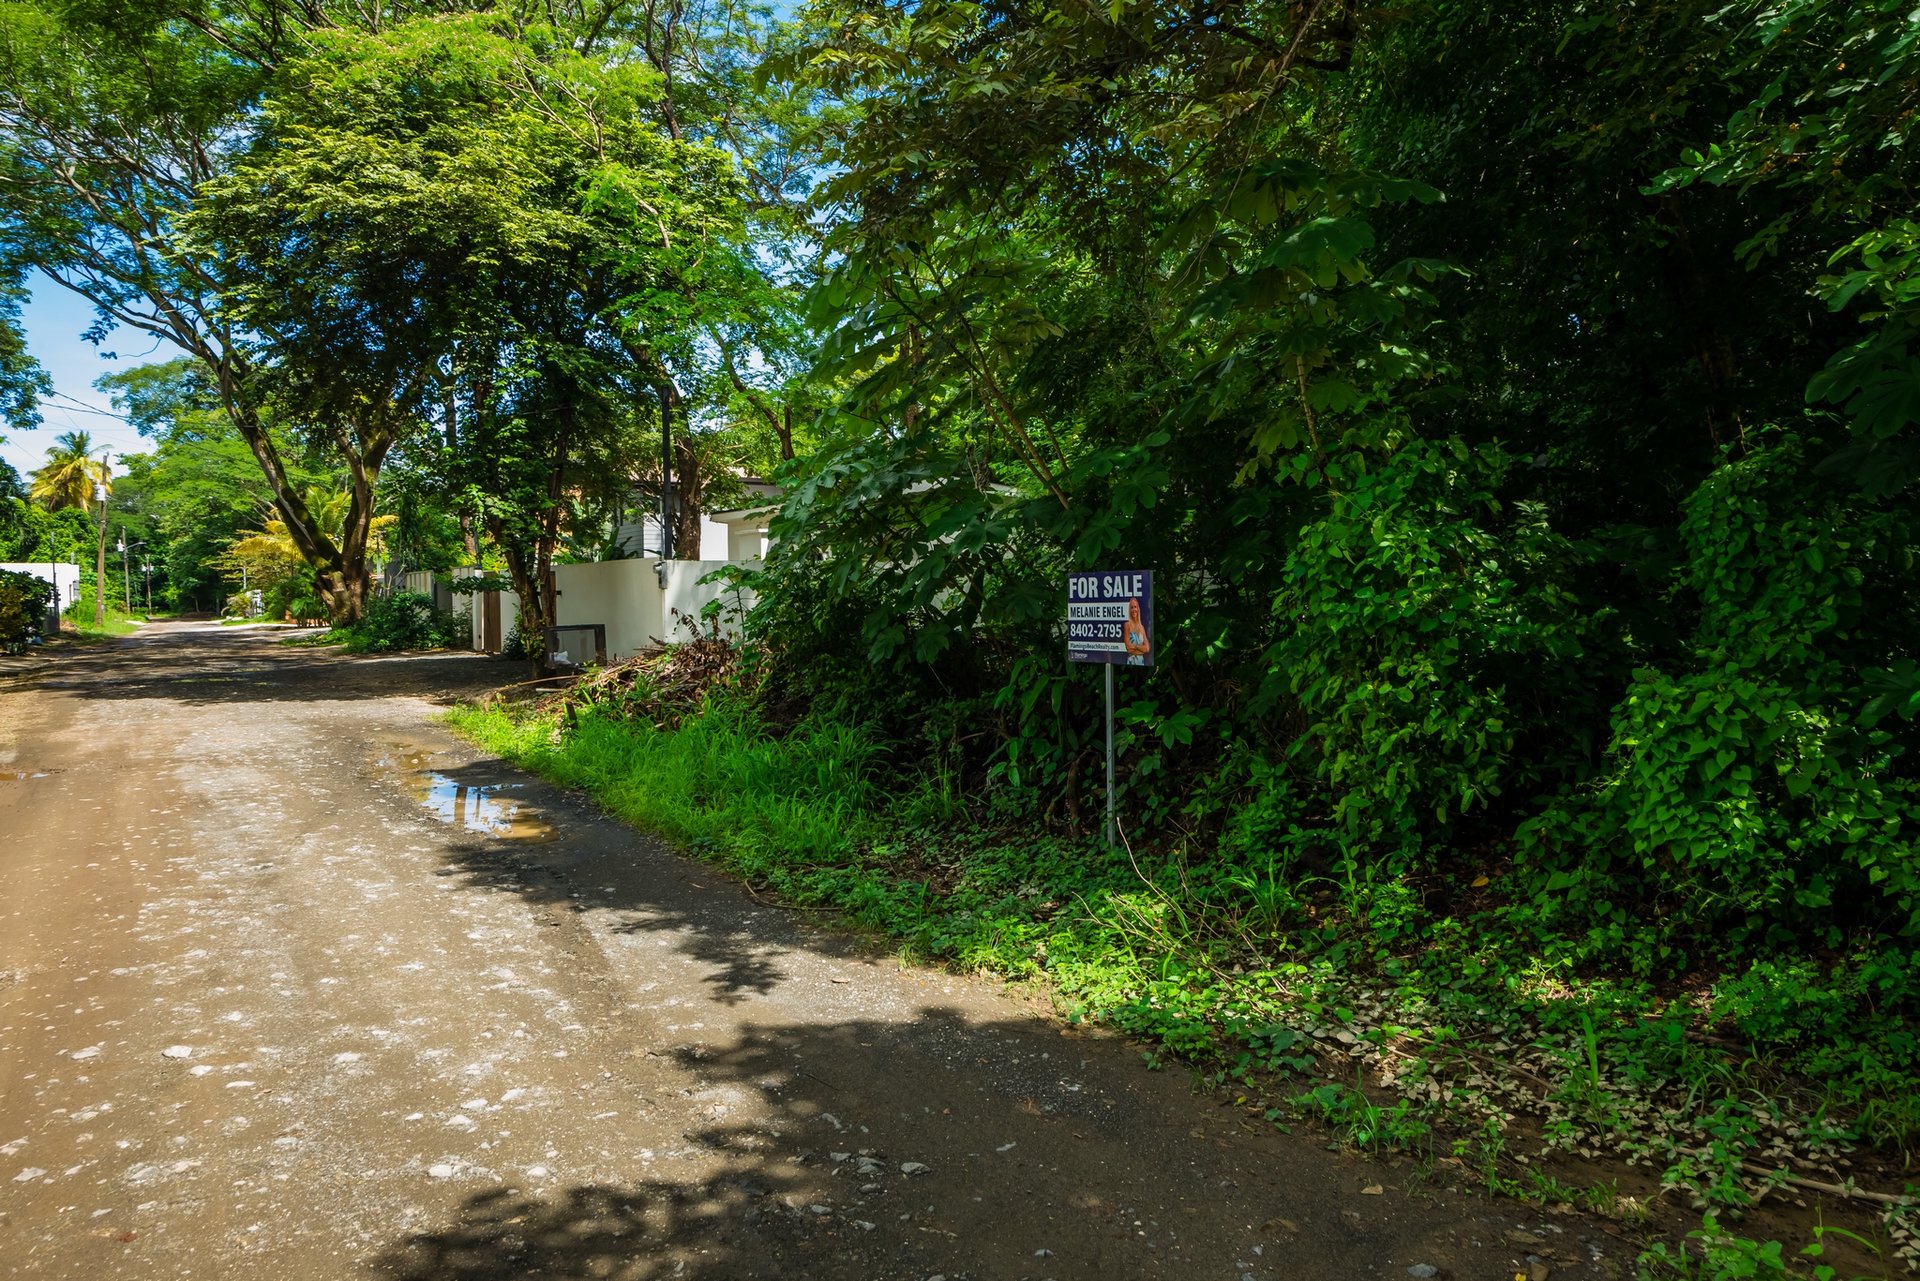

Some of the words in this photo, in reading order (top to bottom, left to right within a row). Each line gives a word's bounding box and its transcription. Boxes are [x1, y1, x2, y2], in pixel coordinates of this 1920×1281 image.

[1069, 577, 1098, 598] FOR
[1103, 575, 1142, 598] SALE
[1070, 606, 1100, 618] MELANIE
[1103, 606, 1125, 618] ENGEL
[1070, 624, 1122, 638] 8402-2795
